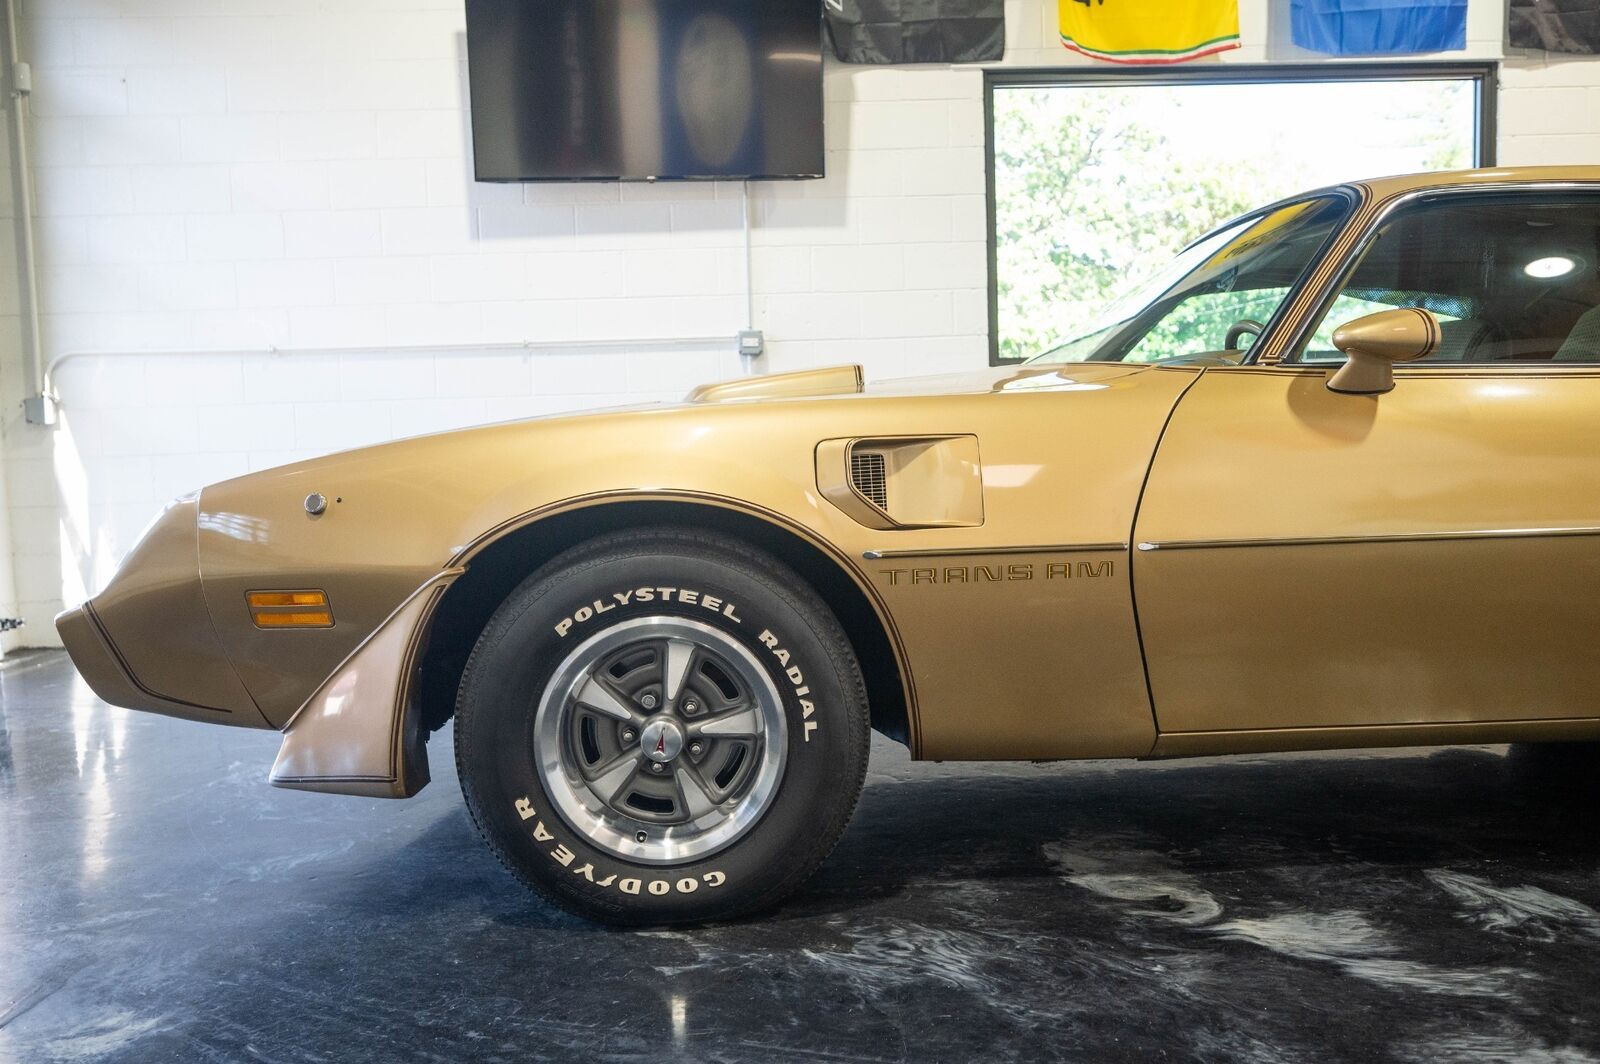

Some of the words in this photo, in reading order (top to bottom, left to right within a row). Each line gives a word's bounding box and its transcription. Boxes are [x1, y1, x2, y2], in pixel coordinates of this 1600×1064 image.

[879, 563, 1033, 586] TRANS
[1046, 560, 1114, 580] AM
[554, 587, 742, 637] POLYSTEEL
[758, 629, 819, 742] RADIAL
[514, 796, 727, 895] GOODYEAR
